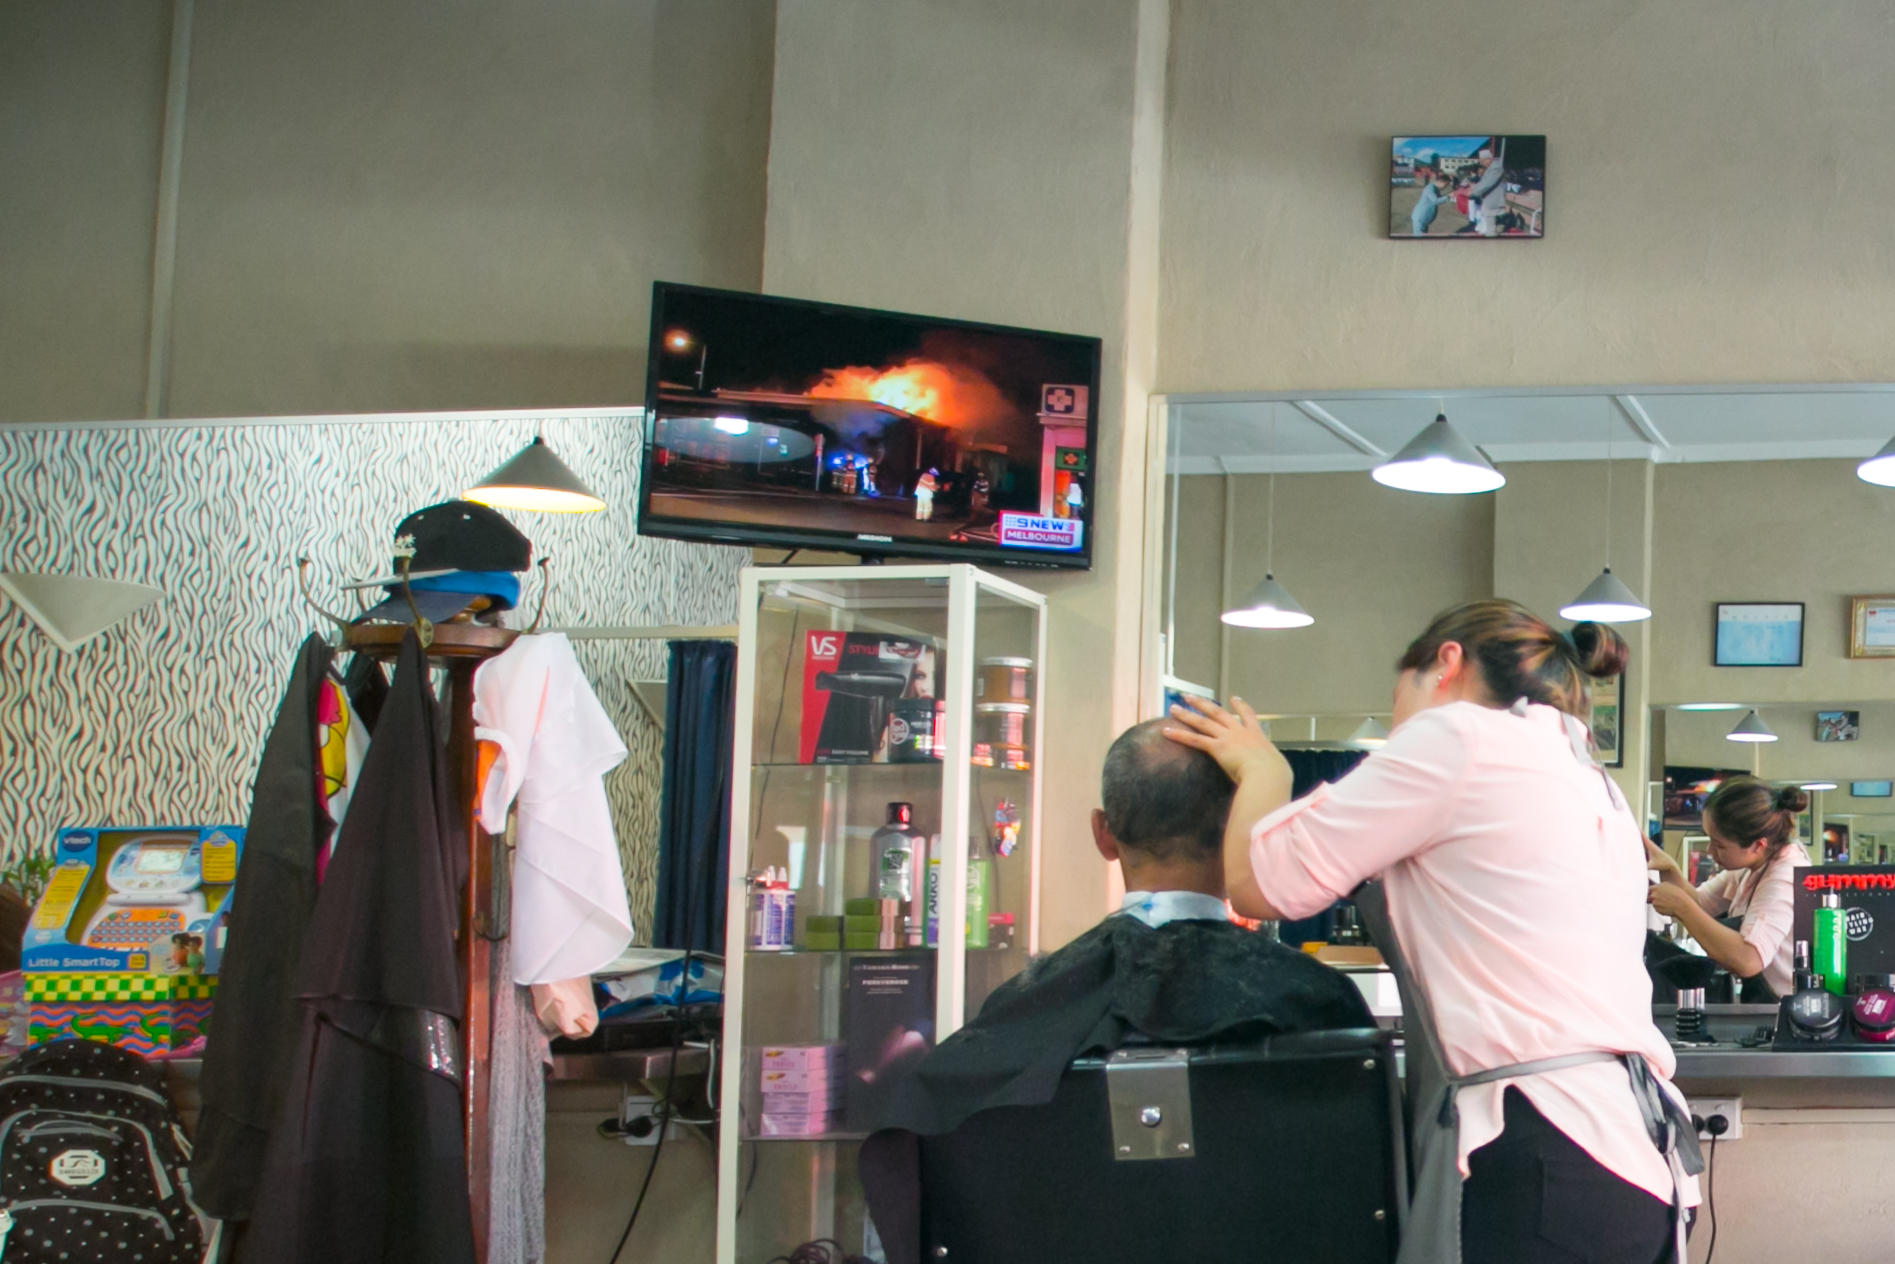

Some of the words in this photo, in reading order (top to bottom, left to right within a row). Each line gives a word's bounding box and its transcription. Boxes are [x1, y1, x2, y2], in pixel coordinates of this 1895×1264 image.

[1007, 531, 1072, 543] MELBOURNE
[811, 635, 837, 656] VS
[848, 644, 879, 656] STYLI
[63, 836, 92, 845] vtech
[1848, 925, 1867, 935] WAX
[28, 957, 60, 967] Little
